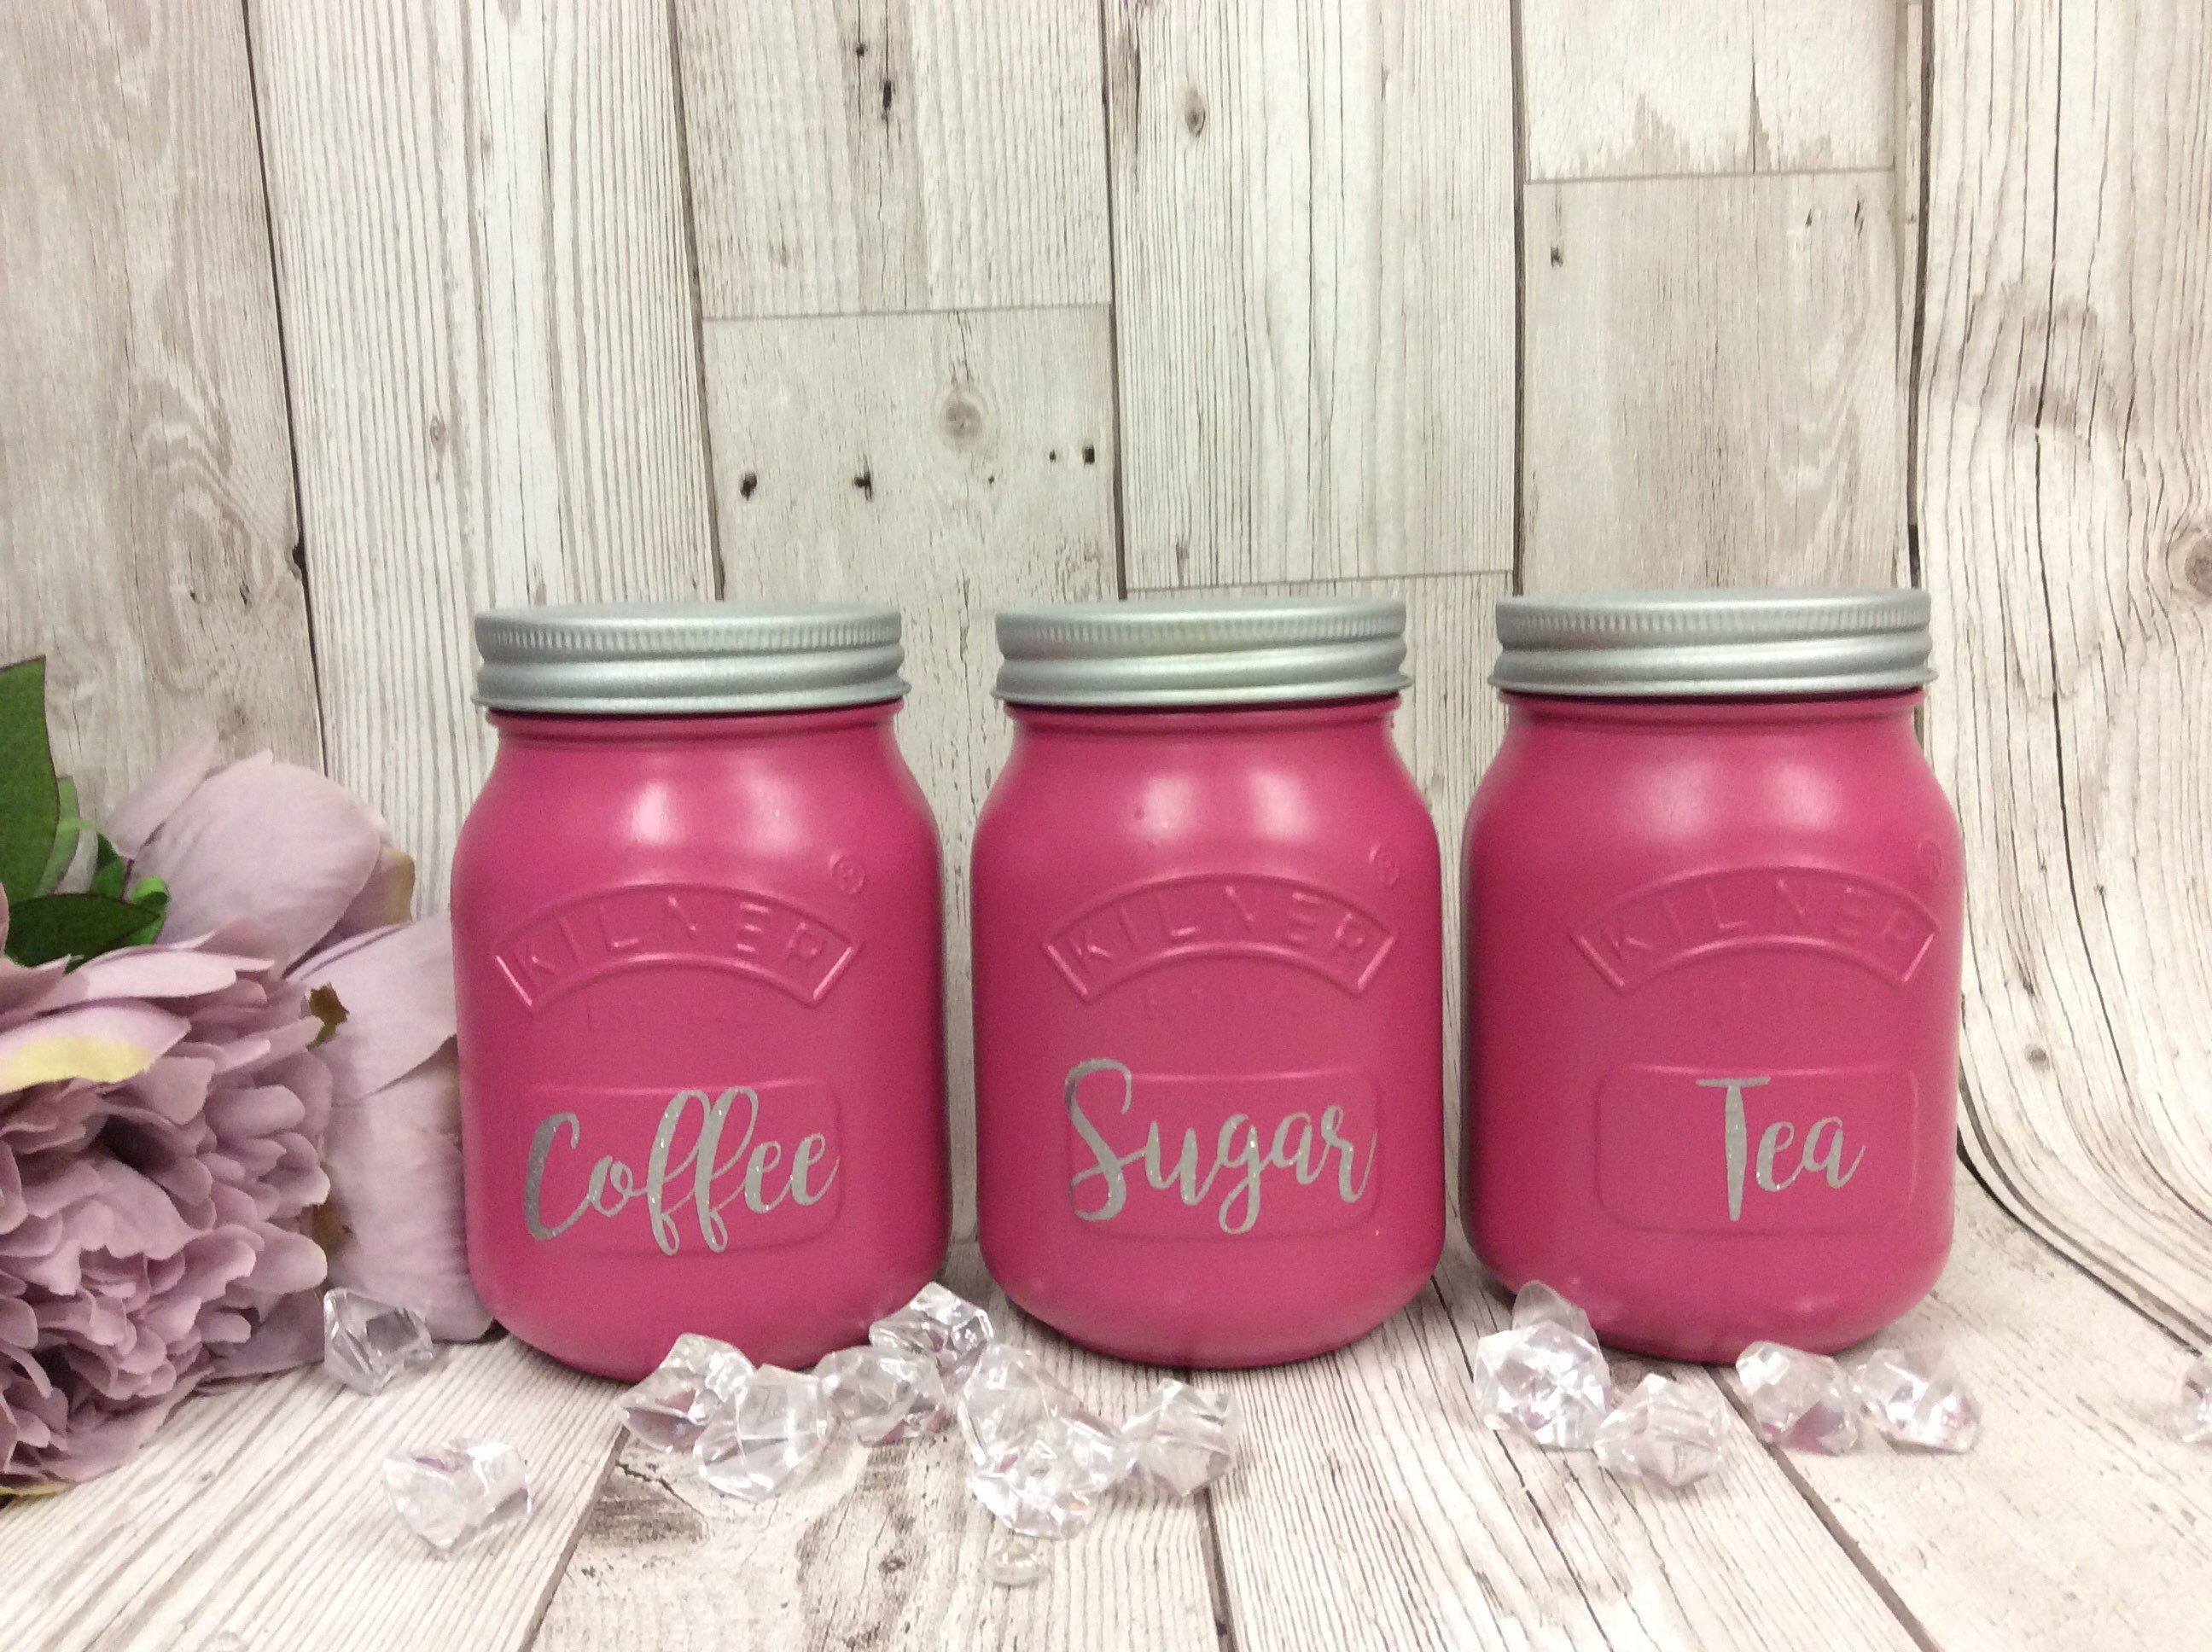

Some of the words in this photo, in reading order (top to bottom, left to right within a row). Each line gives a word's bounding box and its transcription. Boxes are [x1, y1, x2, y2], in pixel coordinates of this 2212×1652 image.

[518, 895, 828, 977] KILNER
[1070, 885, 1365, 970] KILNER
[1603, 879, 1914, 960] KILNER
[527, 1087, 840, 1255] Coffee
[1064, 1058, 1377, 1236] Sugar
[1695, 1076, 1866, 1222] Tea
